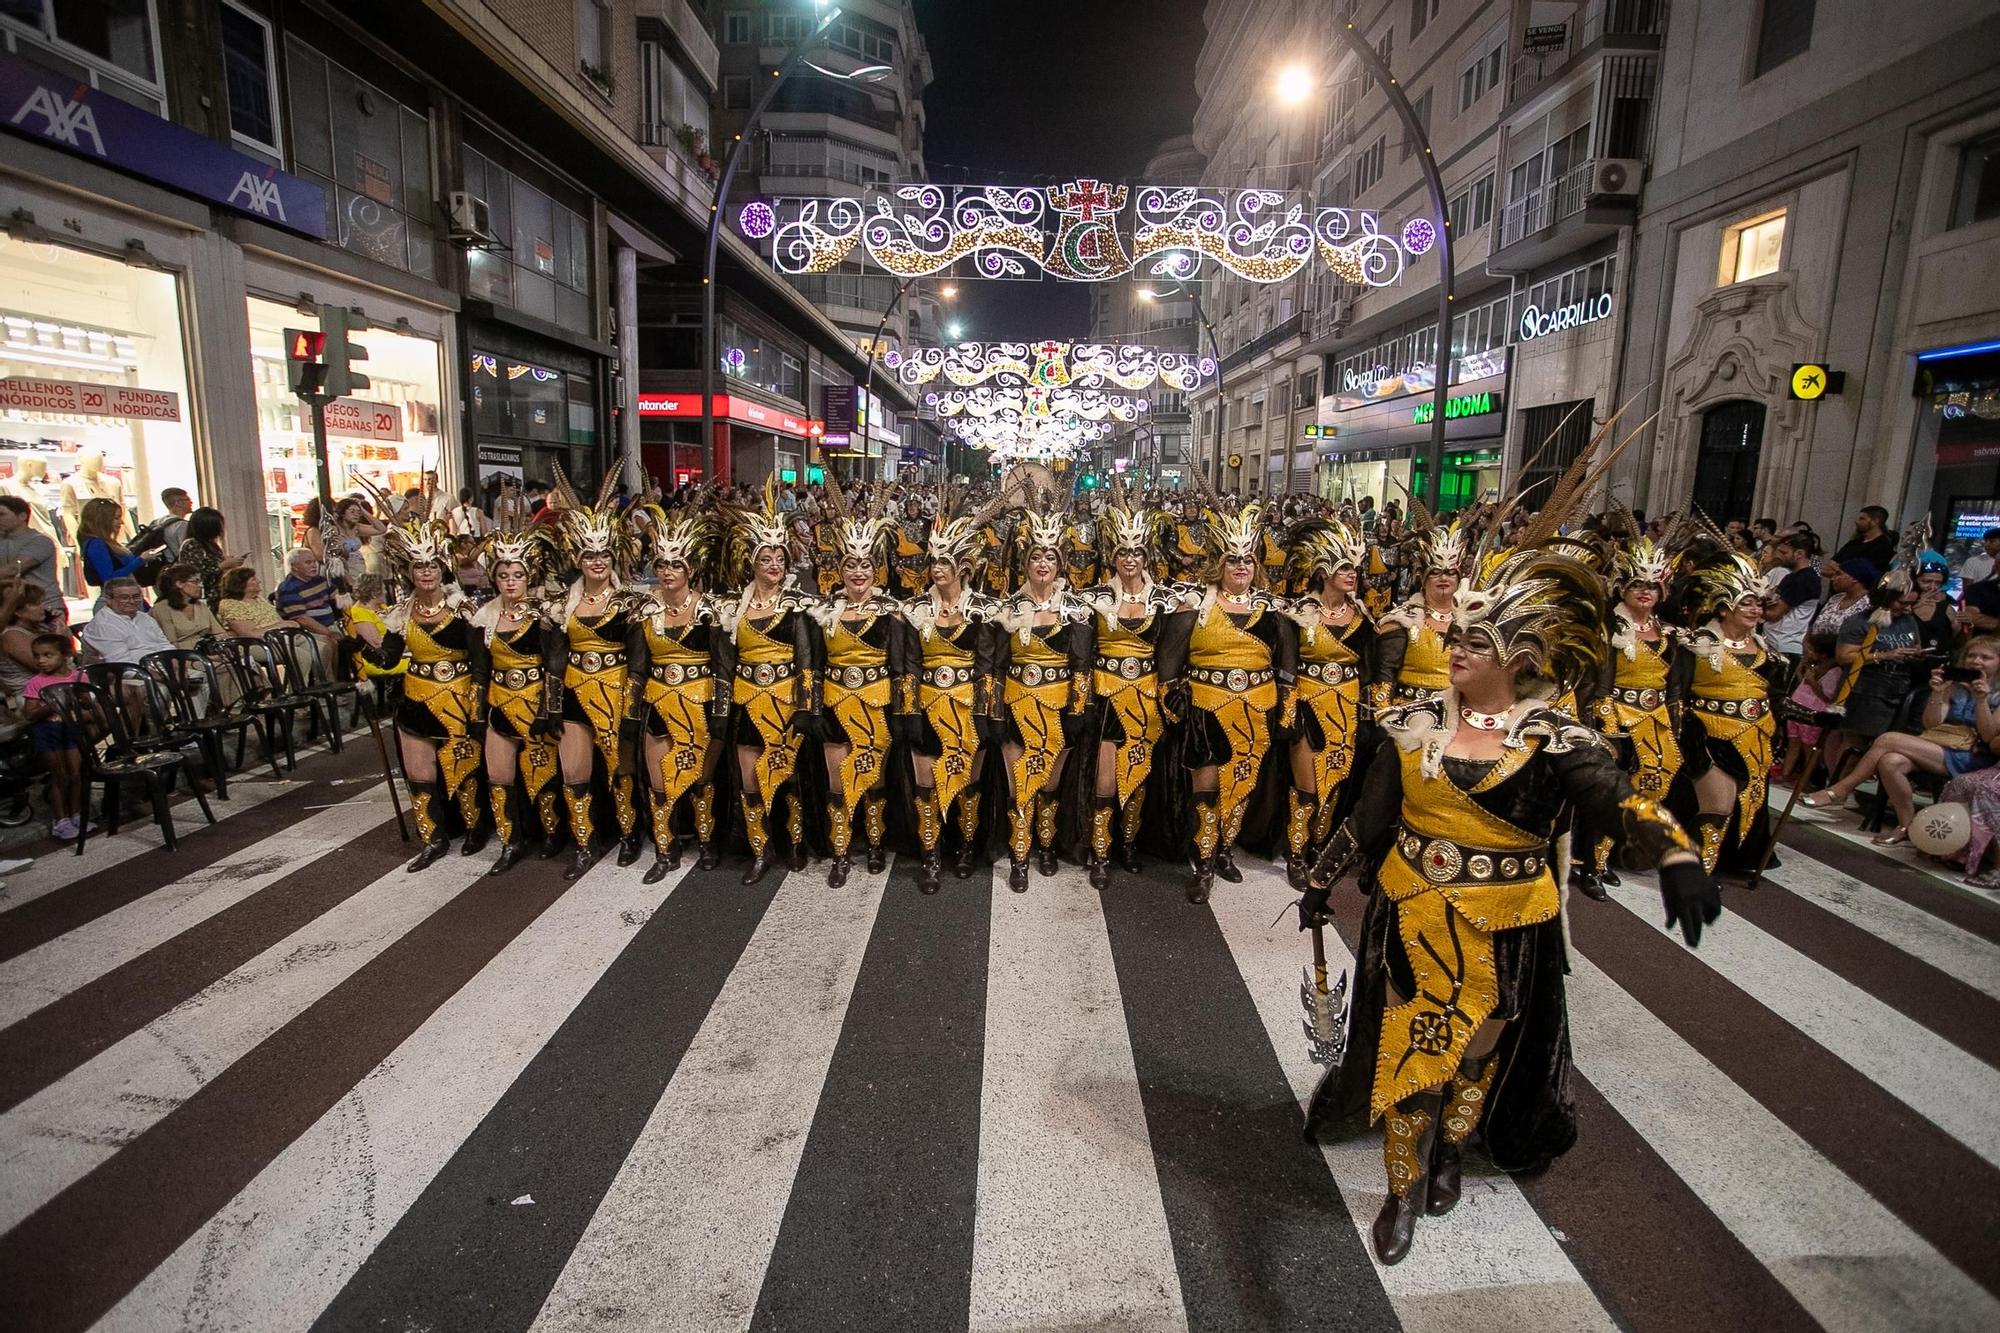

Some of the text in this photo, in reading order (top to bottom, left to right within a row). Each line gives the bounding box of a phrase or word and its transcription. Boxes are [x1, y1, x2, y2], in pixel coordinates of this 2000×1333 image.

[10, 85, 107, 156] AXA
[227, 170, 287, 222] AXA
[1537, 293, 1612, 336] CARRILLO
[0, 380, 74, 396] RELLENOS
[0, 392, 77, 409] NÓRDICOS
[118, 390, 169, 405] FUNDAS
[638, 400, 679, 411] ntander
[113, 402, 177, 418] NÓRDICAS
[326, 403, 360, 417] UEGOS
[1413, 391, 1491, 424] MERADONA
[326, 415, 372, 431] SÁBANAS
